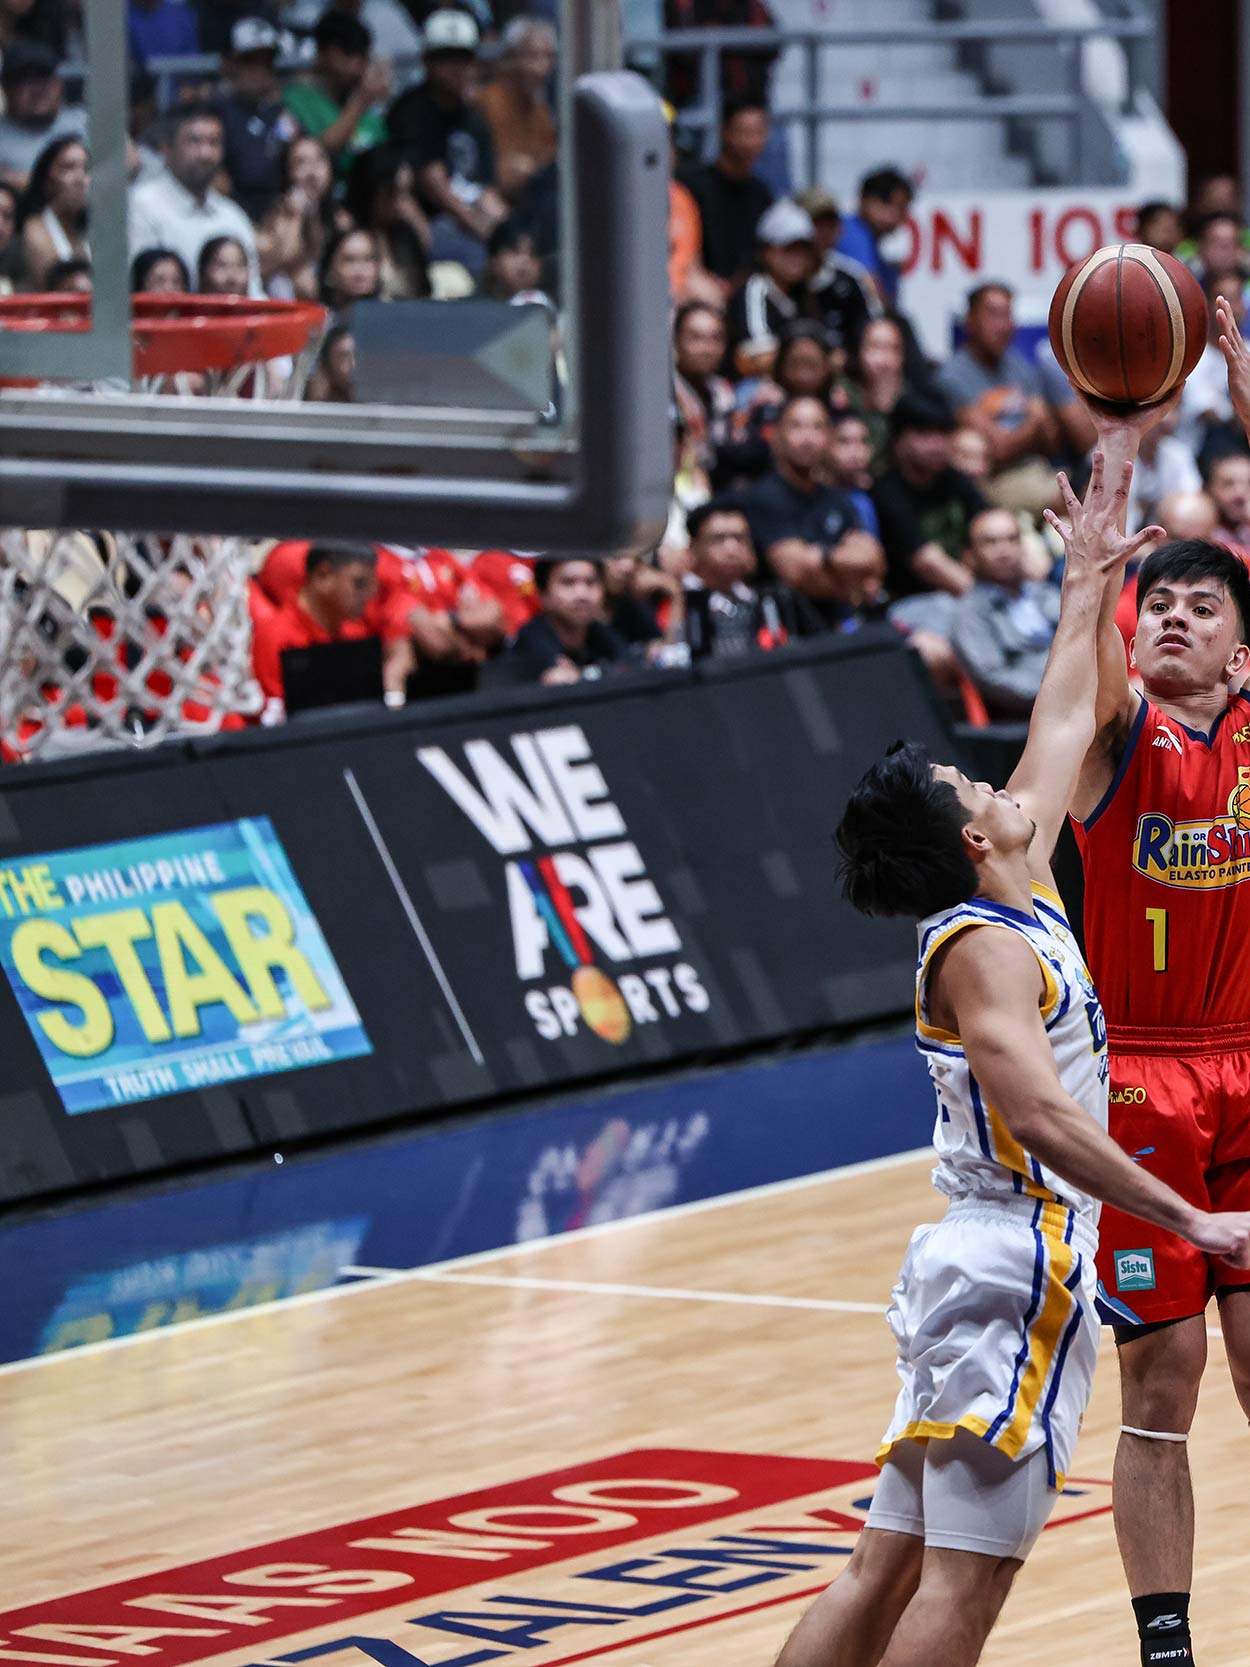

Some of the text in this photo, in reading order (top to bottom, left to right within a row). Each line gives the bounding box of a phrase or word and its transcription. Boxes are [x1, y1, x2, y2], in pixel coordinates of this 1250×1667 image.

[416, 724, 628, 856] WE
[1192, 832, 1207, 841] OR
[0, 849, 227, 918] THE PHILIPPINE
[1169, 868, 1216, 881] ELASTO
[1145, 907, 1168, 972] 1
[9, 885, 333, 1059] STAR
[104, 1066, 179, 1103] TRUTH
[1120, 1260, 1148, 1274] Sista
